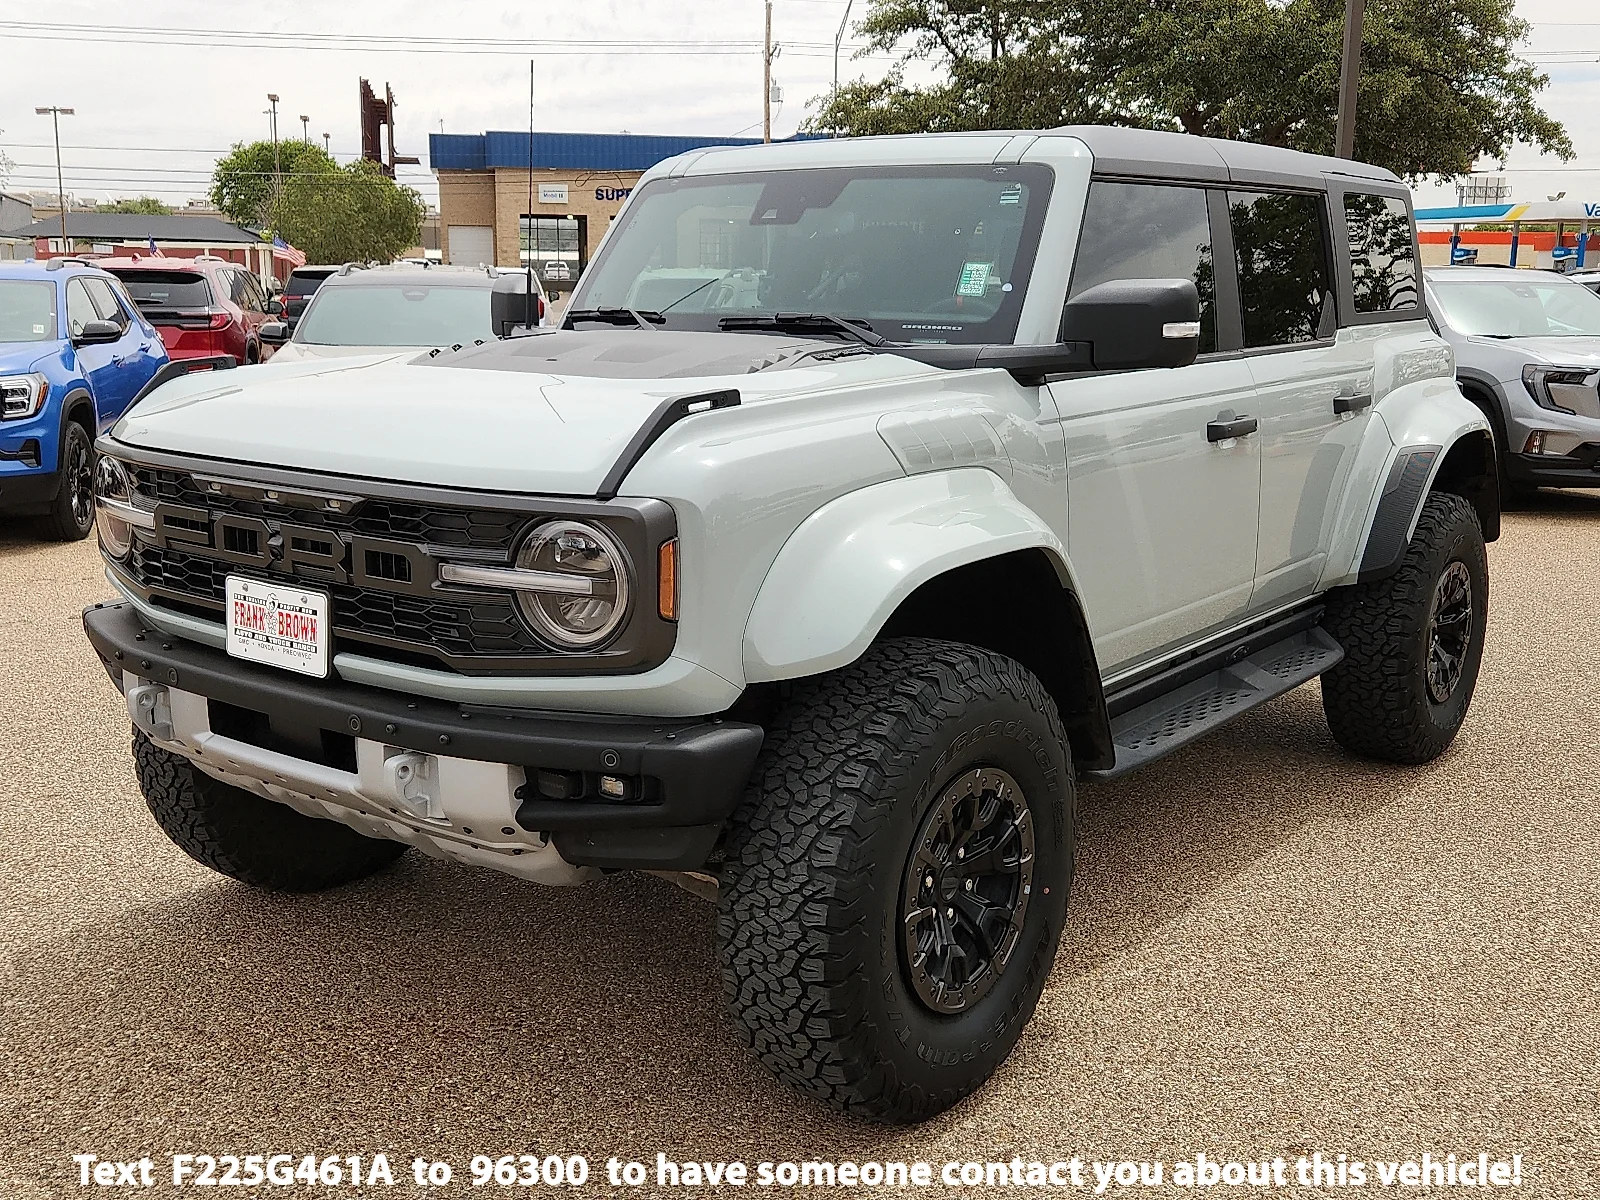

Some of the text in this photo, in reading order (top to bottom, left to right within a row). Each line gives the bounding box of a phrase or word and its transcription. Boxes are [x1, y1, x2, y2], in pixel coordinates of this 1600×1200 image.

[153, 502, 434, 597] FORD
[234, 601, 318, 644] FRANK BROWN
[235, 629, 252, 637] AUTO
[254, 634, 267, 642] AND
[268, 638, 291, 648] TRUCK
[257, 642, 275, 651] HONDA
